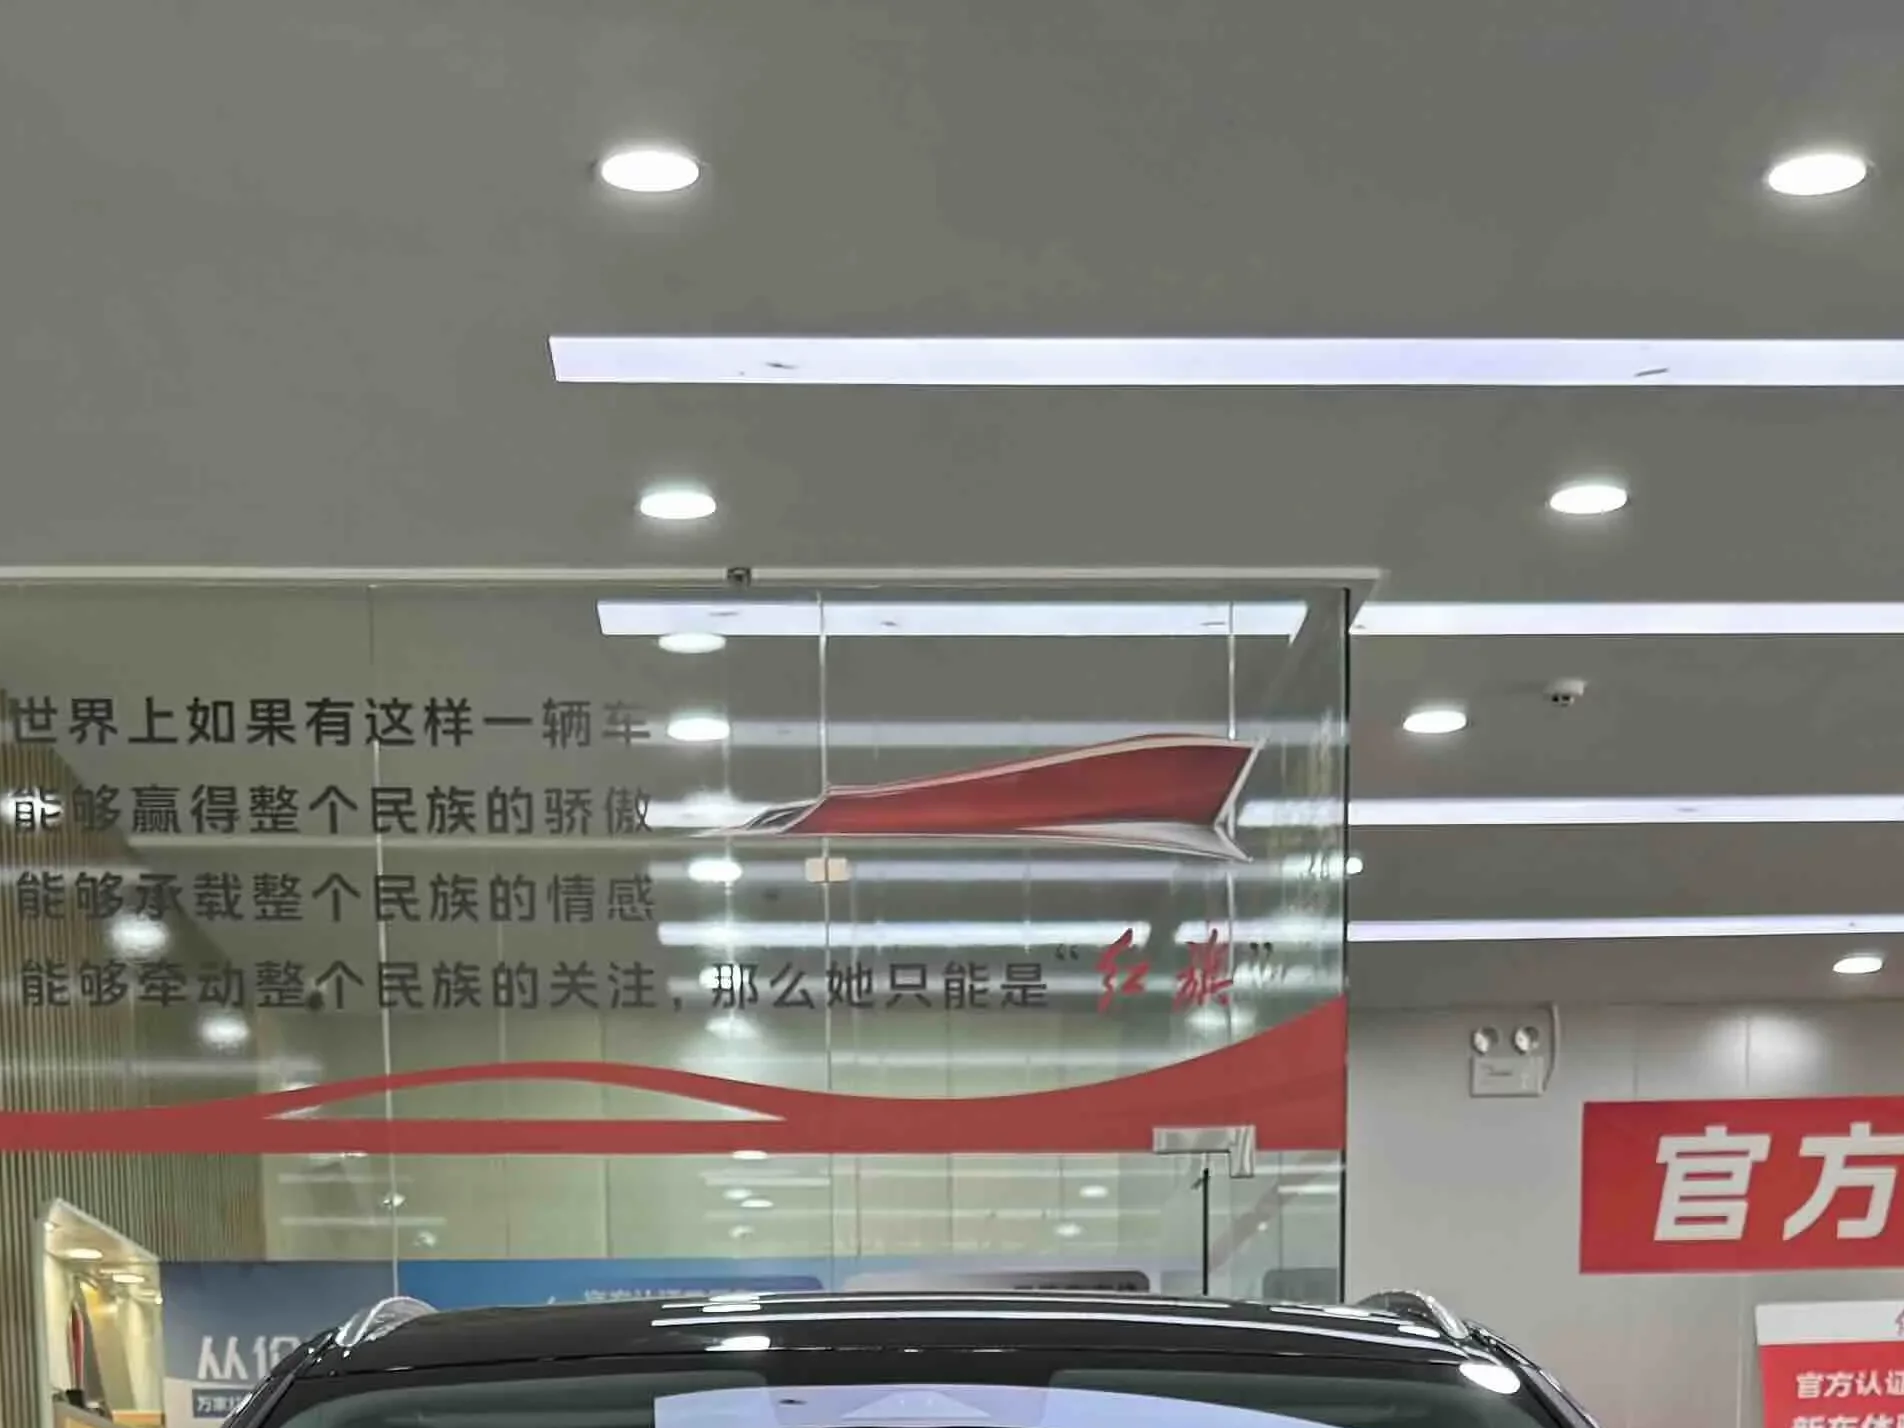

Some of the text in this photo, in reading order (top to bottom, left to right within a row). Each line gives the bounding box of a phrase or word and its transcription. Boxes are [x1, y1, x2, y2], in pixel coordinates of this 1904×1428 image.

[13, 696, 652, 748] 世界上如果有这样一辆车
[13, 783, 653, 836] 能够赢得整个民族的骄傲
[16, 871, 656, 924] 能够承载整个民族的情感
